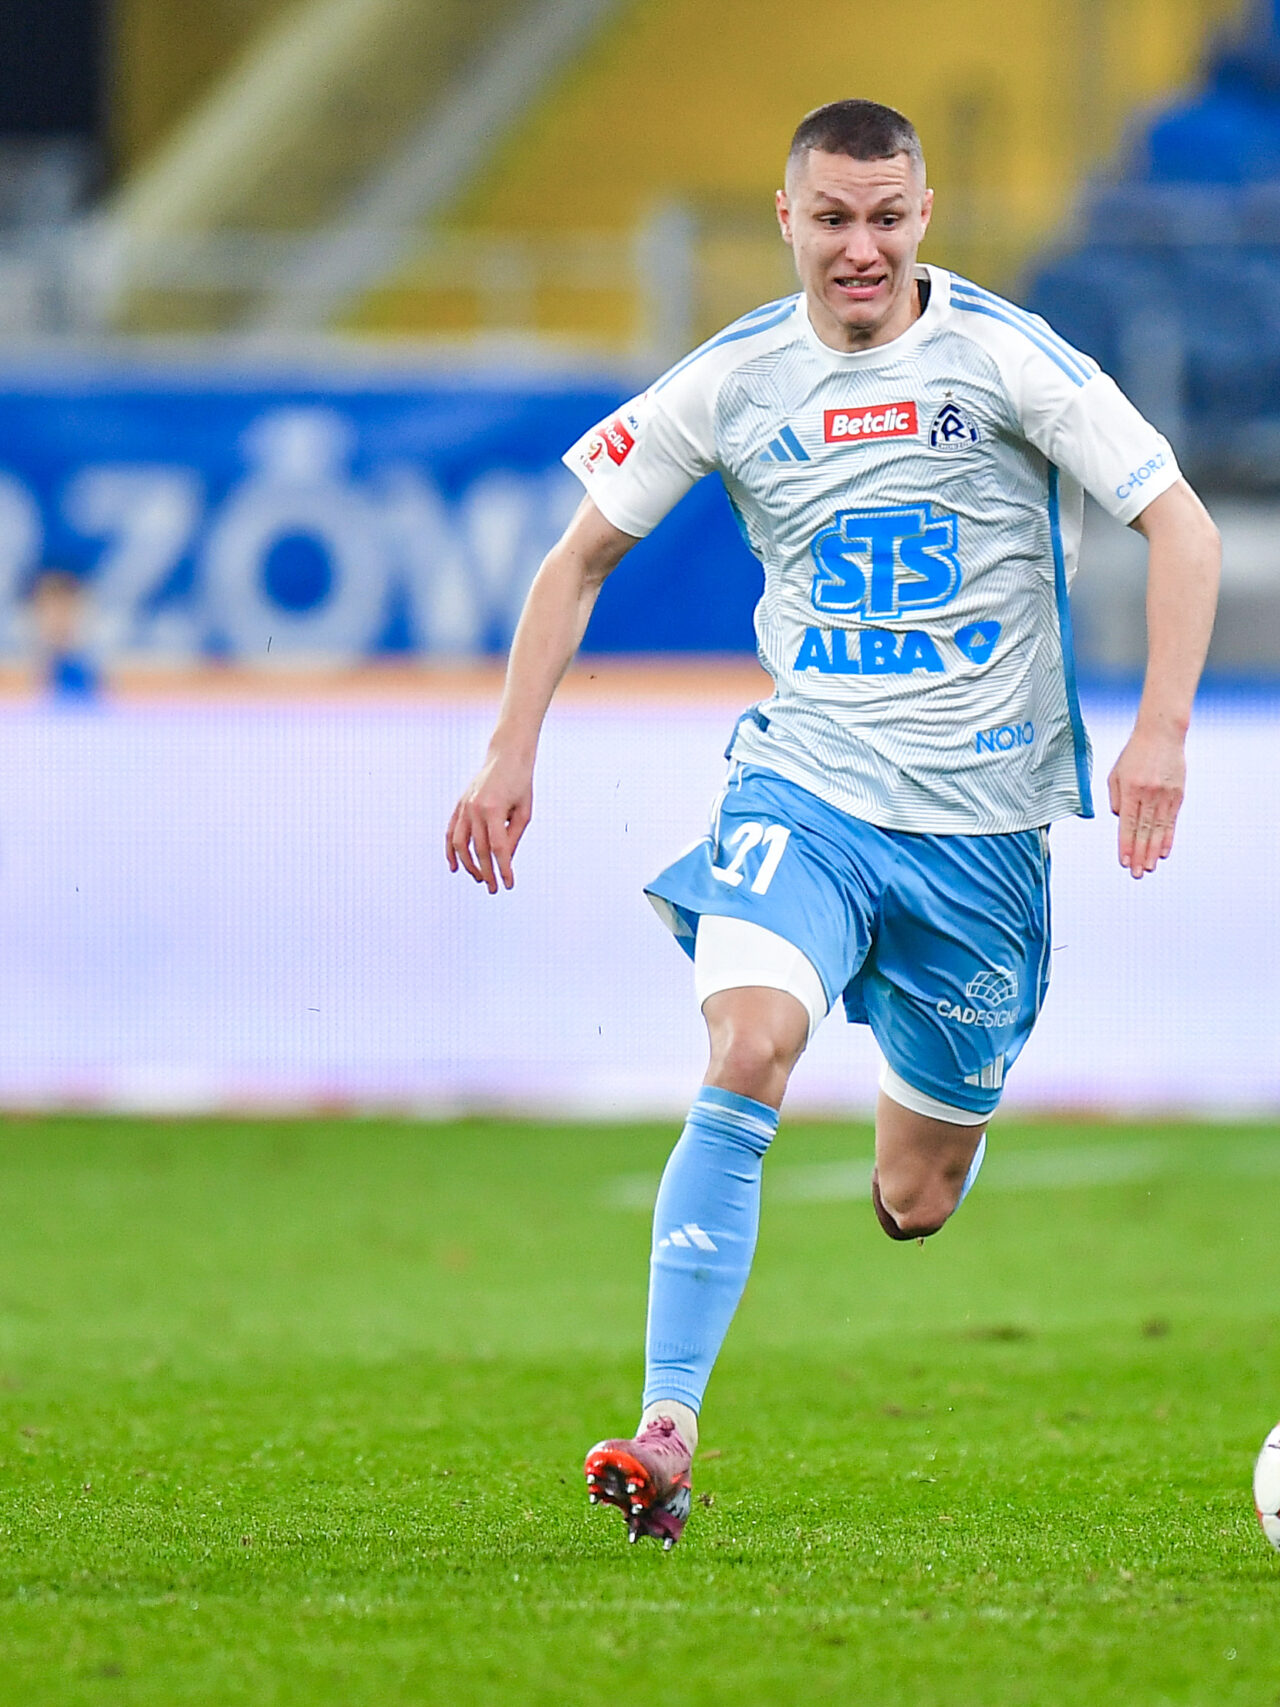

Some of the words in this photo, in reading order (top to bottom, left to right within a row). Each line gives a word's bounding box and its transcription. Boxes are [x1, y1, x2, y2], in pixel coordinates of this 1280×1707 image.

[831, 407, 910, 437] Betclic
[0, 405, 590, 670] ZÓW
[811, 503, 962, 621] STS
[793, 626, 946, 675] ALBA
[976, 721, 1034, 754] NO10
[711, 821, 791, 896] 21
